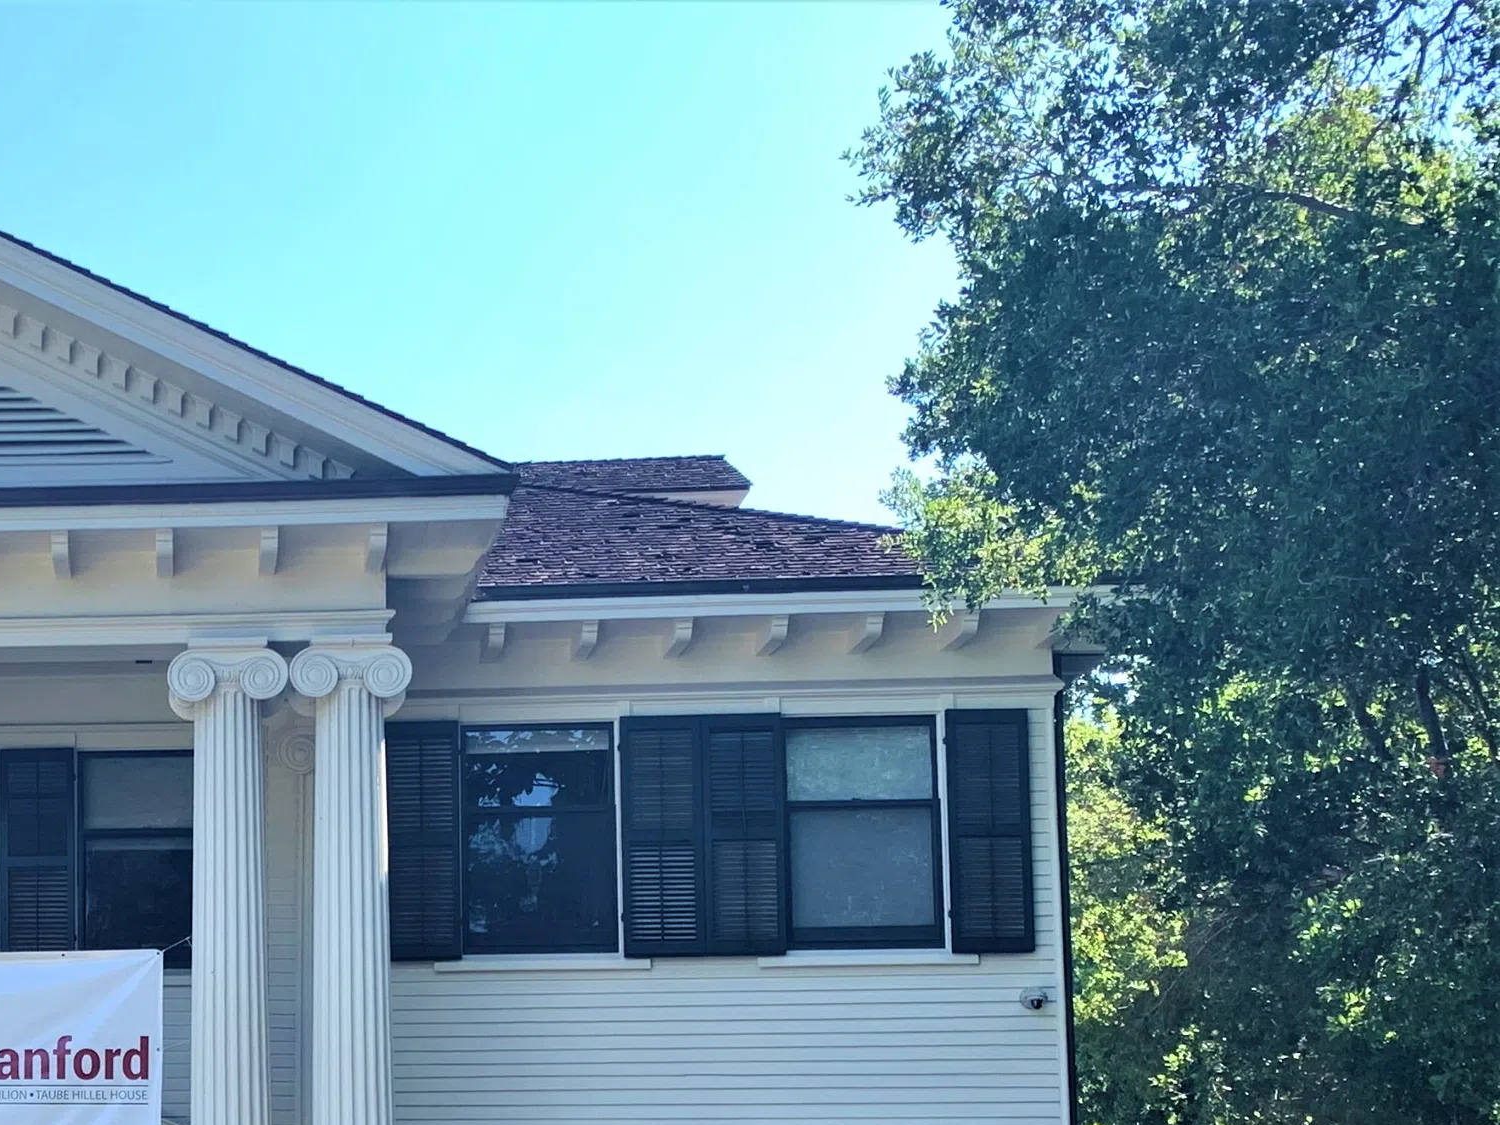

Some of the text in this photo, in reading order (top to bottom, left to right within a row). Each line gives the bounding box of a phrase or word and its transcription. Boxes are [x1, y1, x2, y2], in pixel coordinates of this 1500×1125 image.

[36, 1090, 69, 1100] TAUBE
[72, 1090, 107, 1100] HILLEL
[110, 1090, 148, 1101] HOUSE
